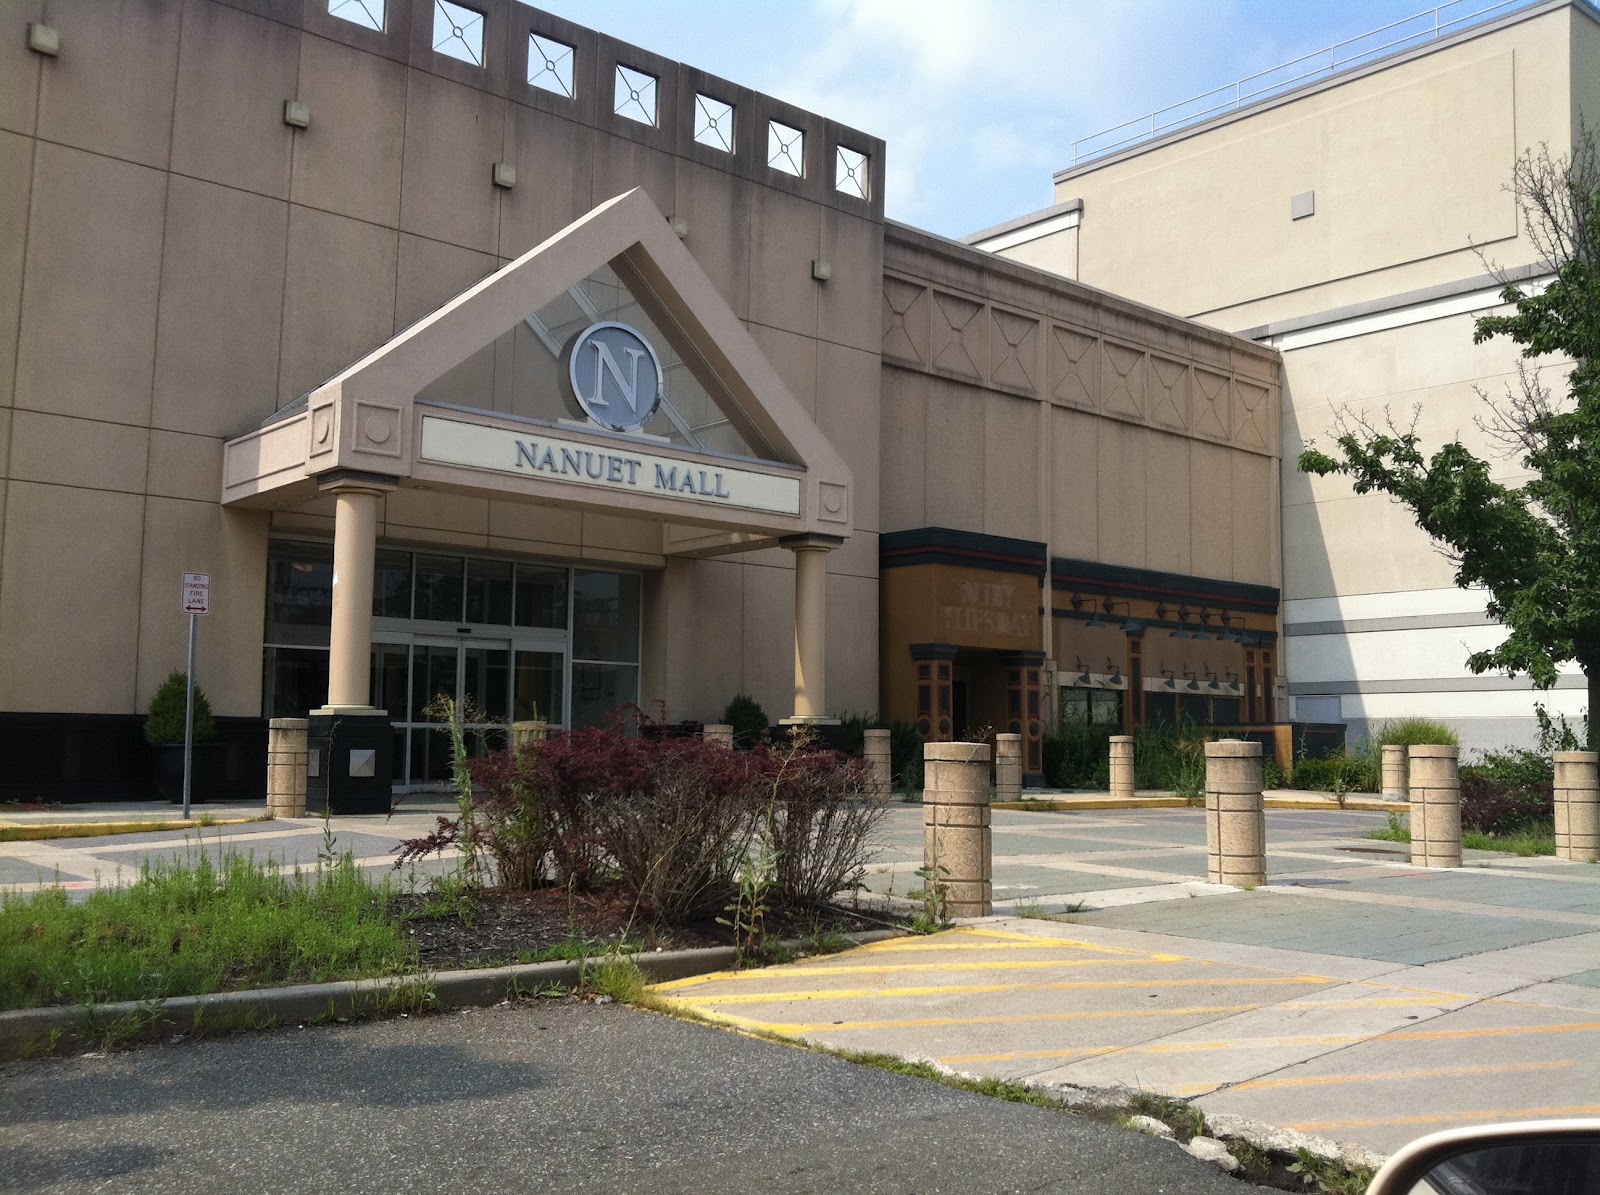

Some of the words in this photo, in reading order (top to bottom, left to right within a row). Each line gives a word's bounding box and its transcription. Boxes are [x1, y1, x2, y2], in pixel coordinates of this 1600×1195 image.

[586, 339, 646, 418] N
[515, 439, 641, 485] NANUET
[654, 463, 730, 498] MALL
[184, 582, 208, 590] STANDING
